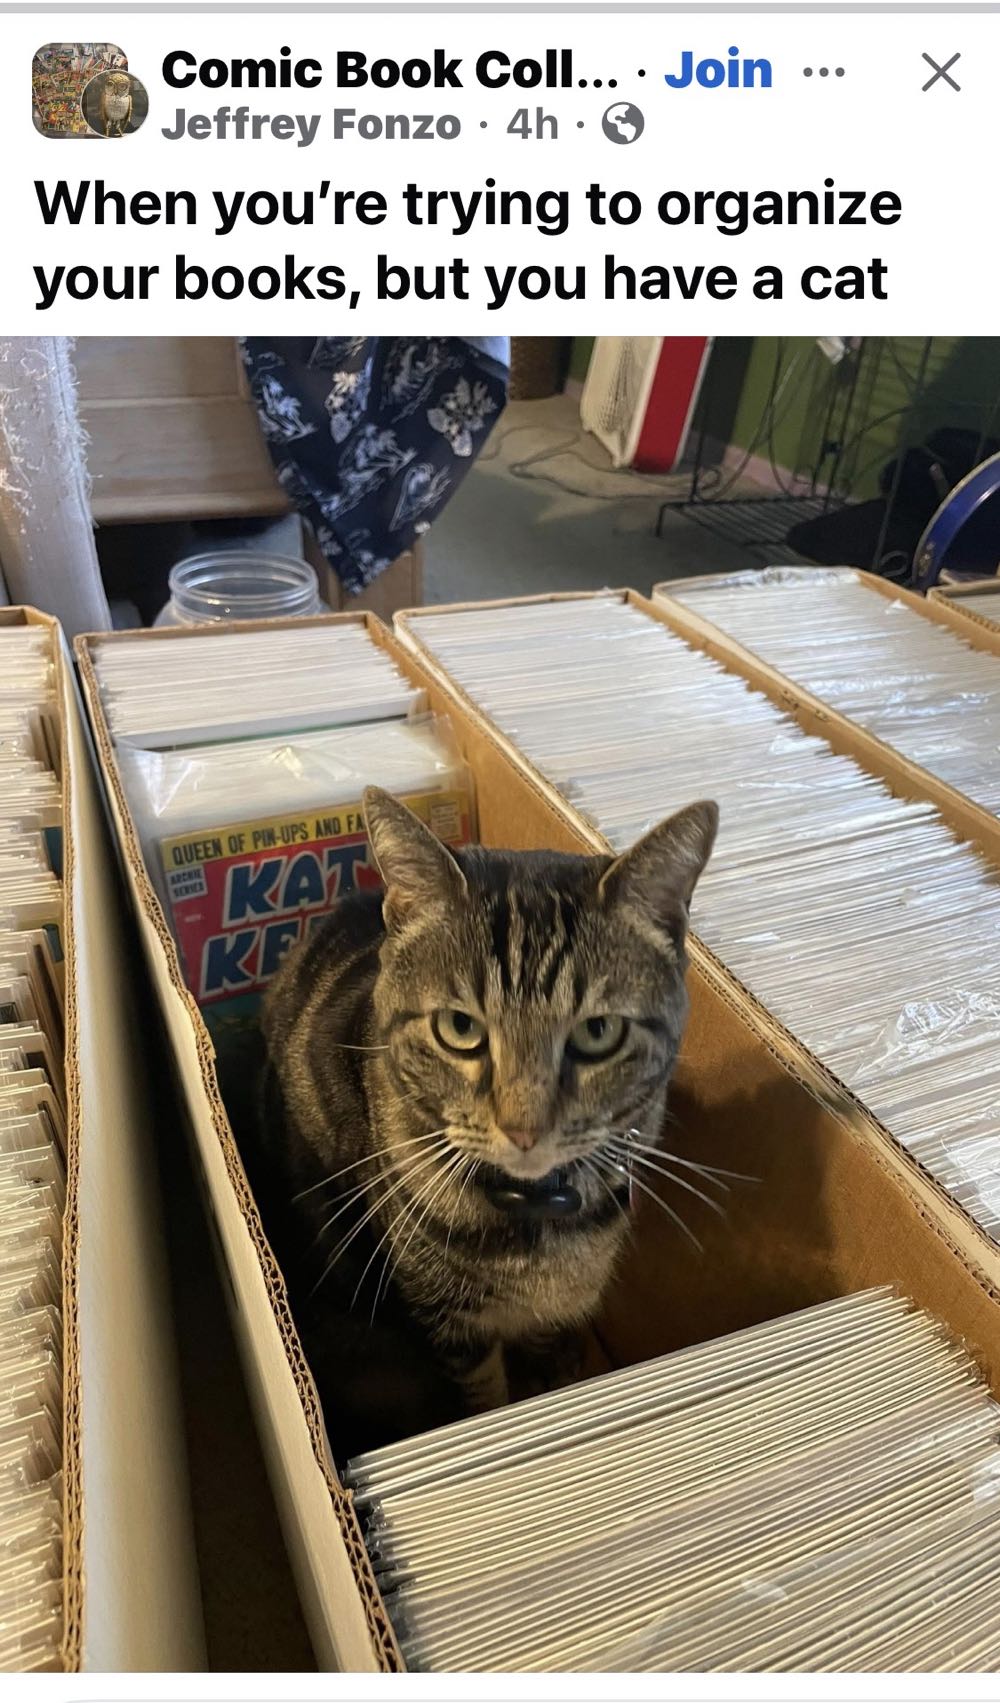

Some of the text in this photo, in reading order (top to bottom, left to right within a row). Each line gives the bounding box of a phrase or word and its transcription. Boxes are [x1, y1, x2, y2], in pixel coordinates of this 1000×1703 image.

[172, 839, 223, 866] QUEEN
[228, 833, 246, 854] OF
[252, 822, 309, 850] PIN-UPS
[315, 816, 341, 839] AND
[200, 912, 333, 998] KE
